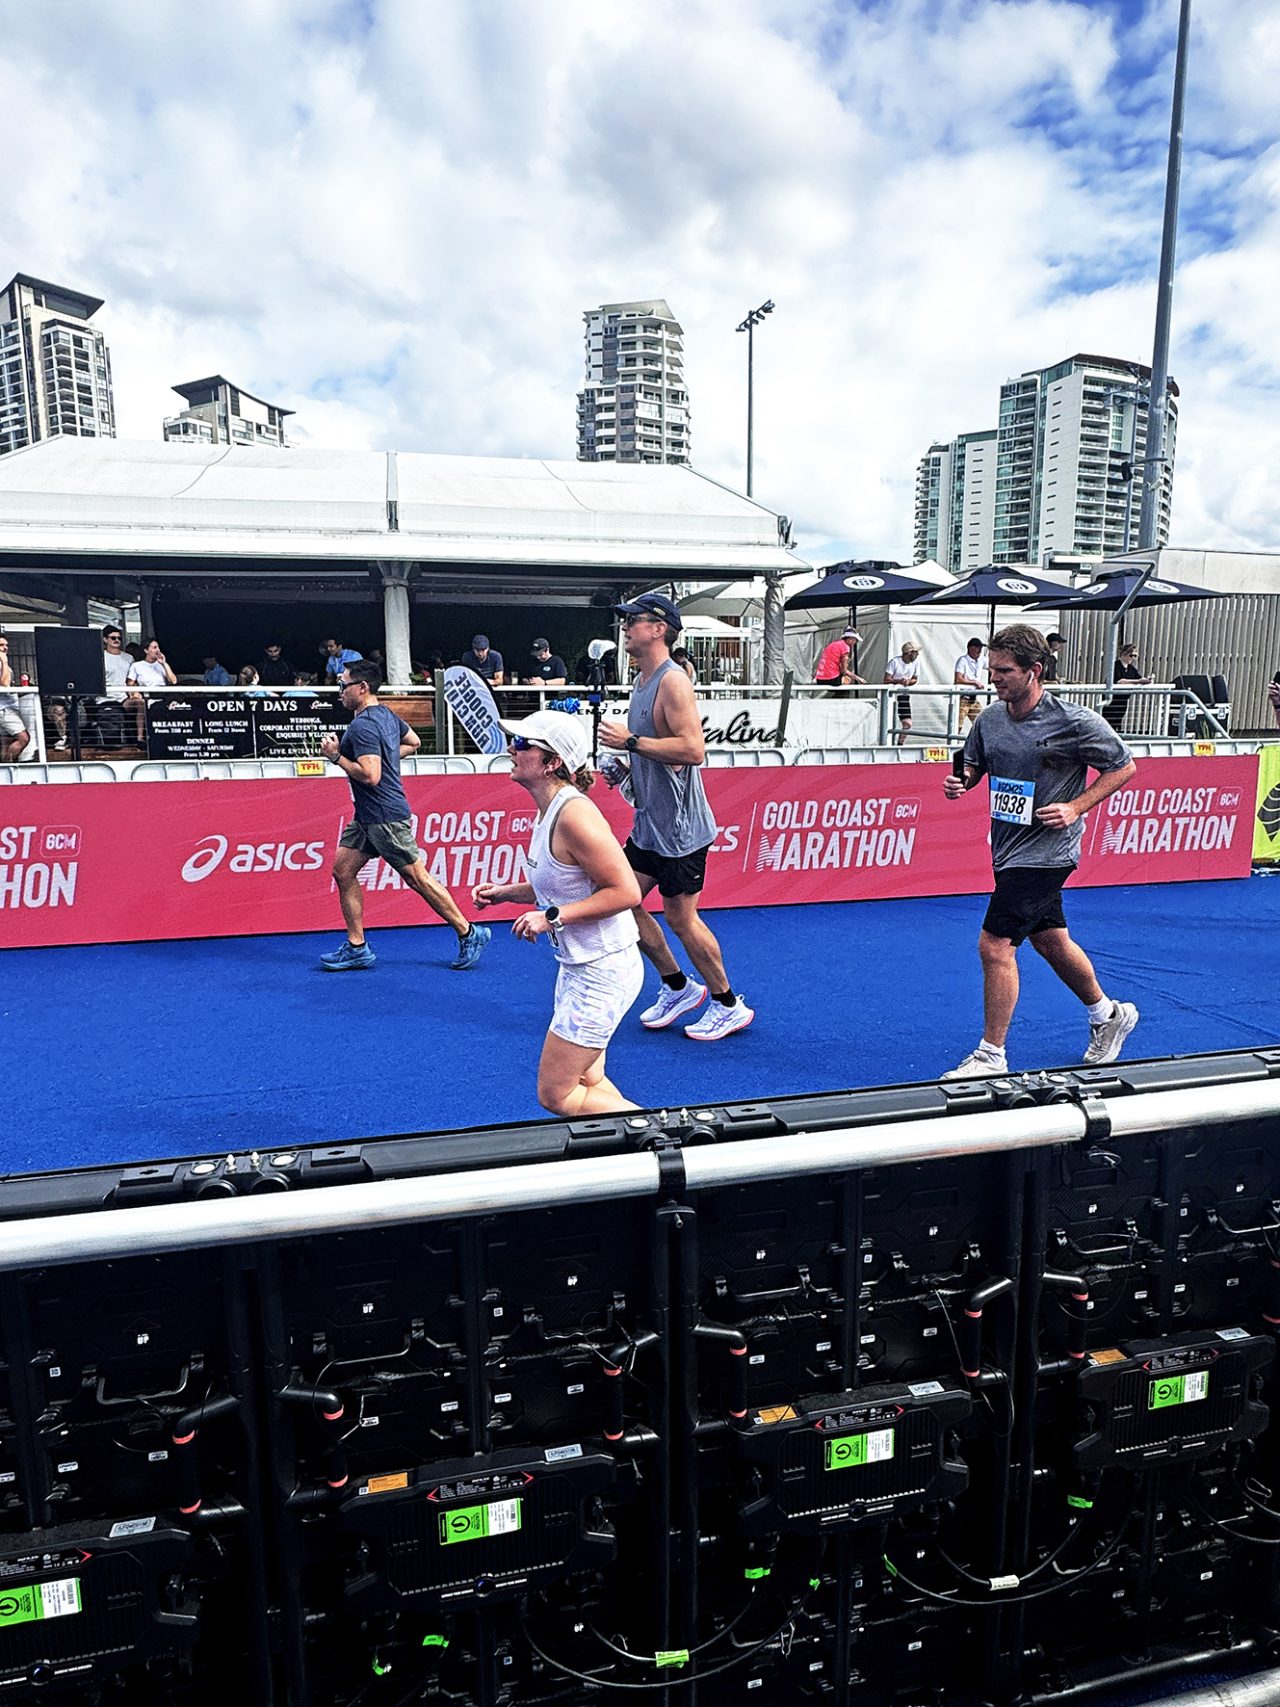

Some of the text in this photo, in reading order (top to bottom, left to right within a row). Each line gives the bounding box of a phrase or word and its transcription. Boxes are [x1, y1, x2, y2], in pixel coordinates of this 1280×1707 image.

[207, 700, 245, 712] OPEN
[249, 700, 258, 712] 7
[263, 700, 298, 711] DAYS
[895, 804, 918, 818] GCM
[994, 793, 1027, 815] 11938
[1107, 787, 1217, 817] GOLD COAST
[1219, 793, 1240, 806] GCM
[762, 798, 891, 830] GOLD COAST
[423, 811, 506, 844] COAST
[1101, 815, 1237, 855] MARATHON
[45, 833, 77, 850] GCM
[756, 827, 916, 872] MARATHON
